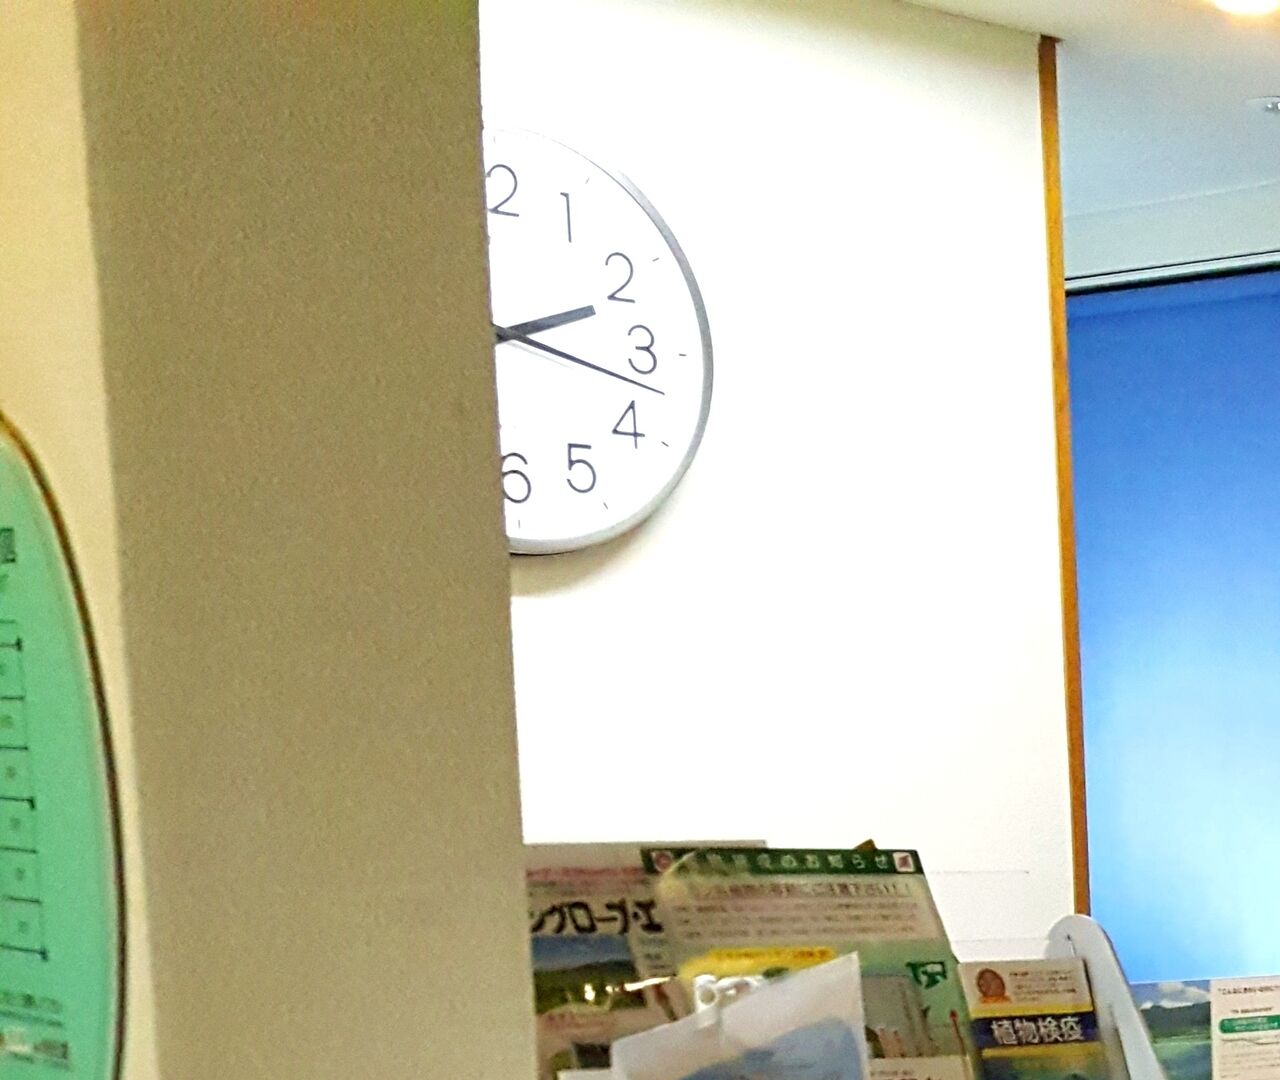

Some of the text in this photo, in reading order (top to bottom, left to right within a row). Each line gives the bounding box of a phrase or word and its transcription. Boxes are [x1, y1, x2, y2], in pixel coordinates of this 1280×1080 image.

[560, 192, 573, 243] 1
[604, 252, 636, 303] 2
[627, 324, 657, 375] 3
[612, 400, 646, 449] 4
[501, 452, 532, 503] 6
[566, 443, 597, 493] 5
[991, 1015, 1084, 1046] 植物検疫
